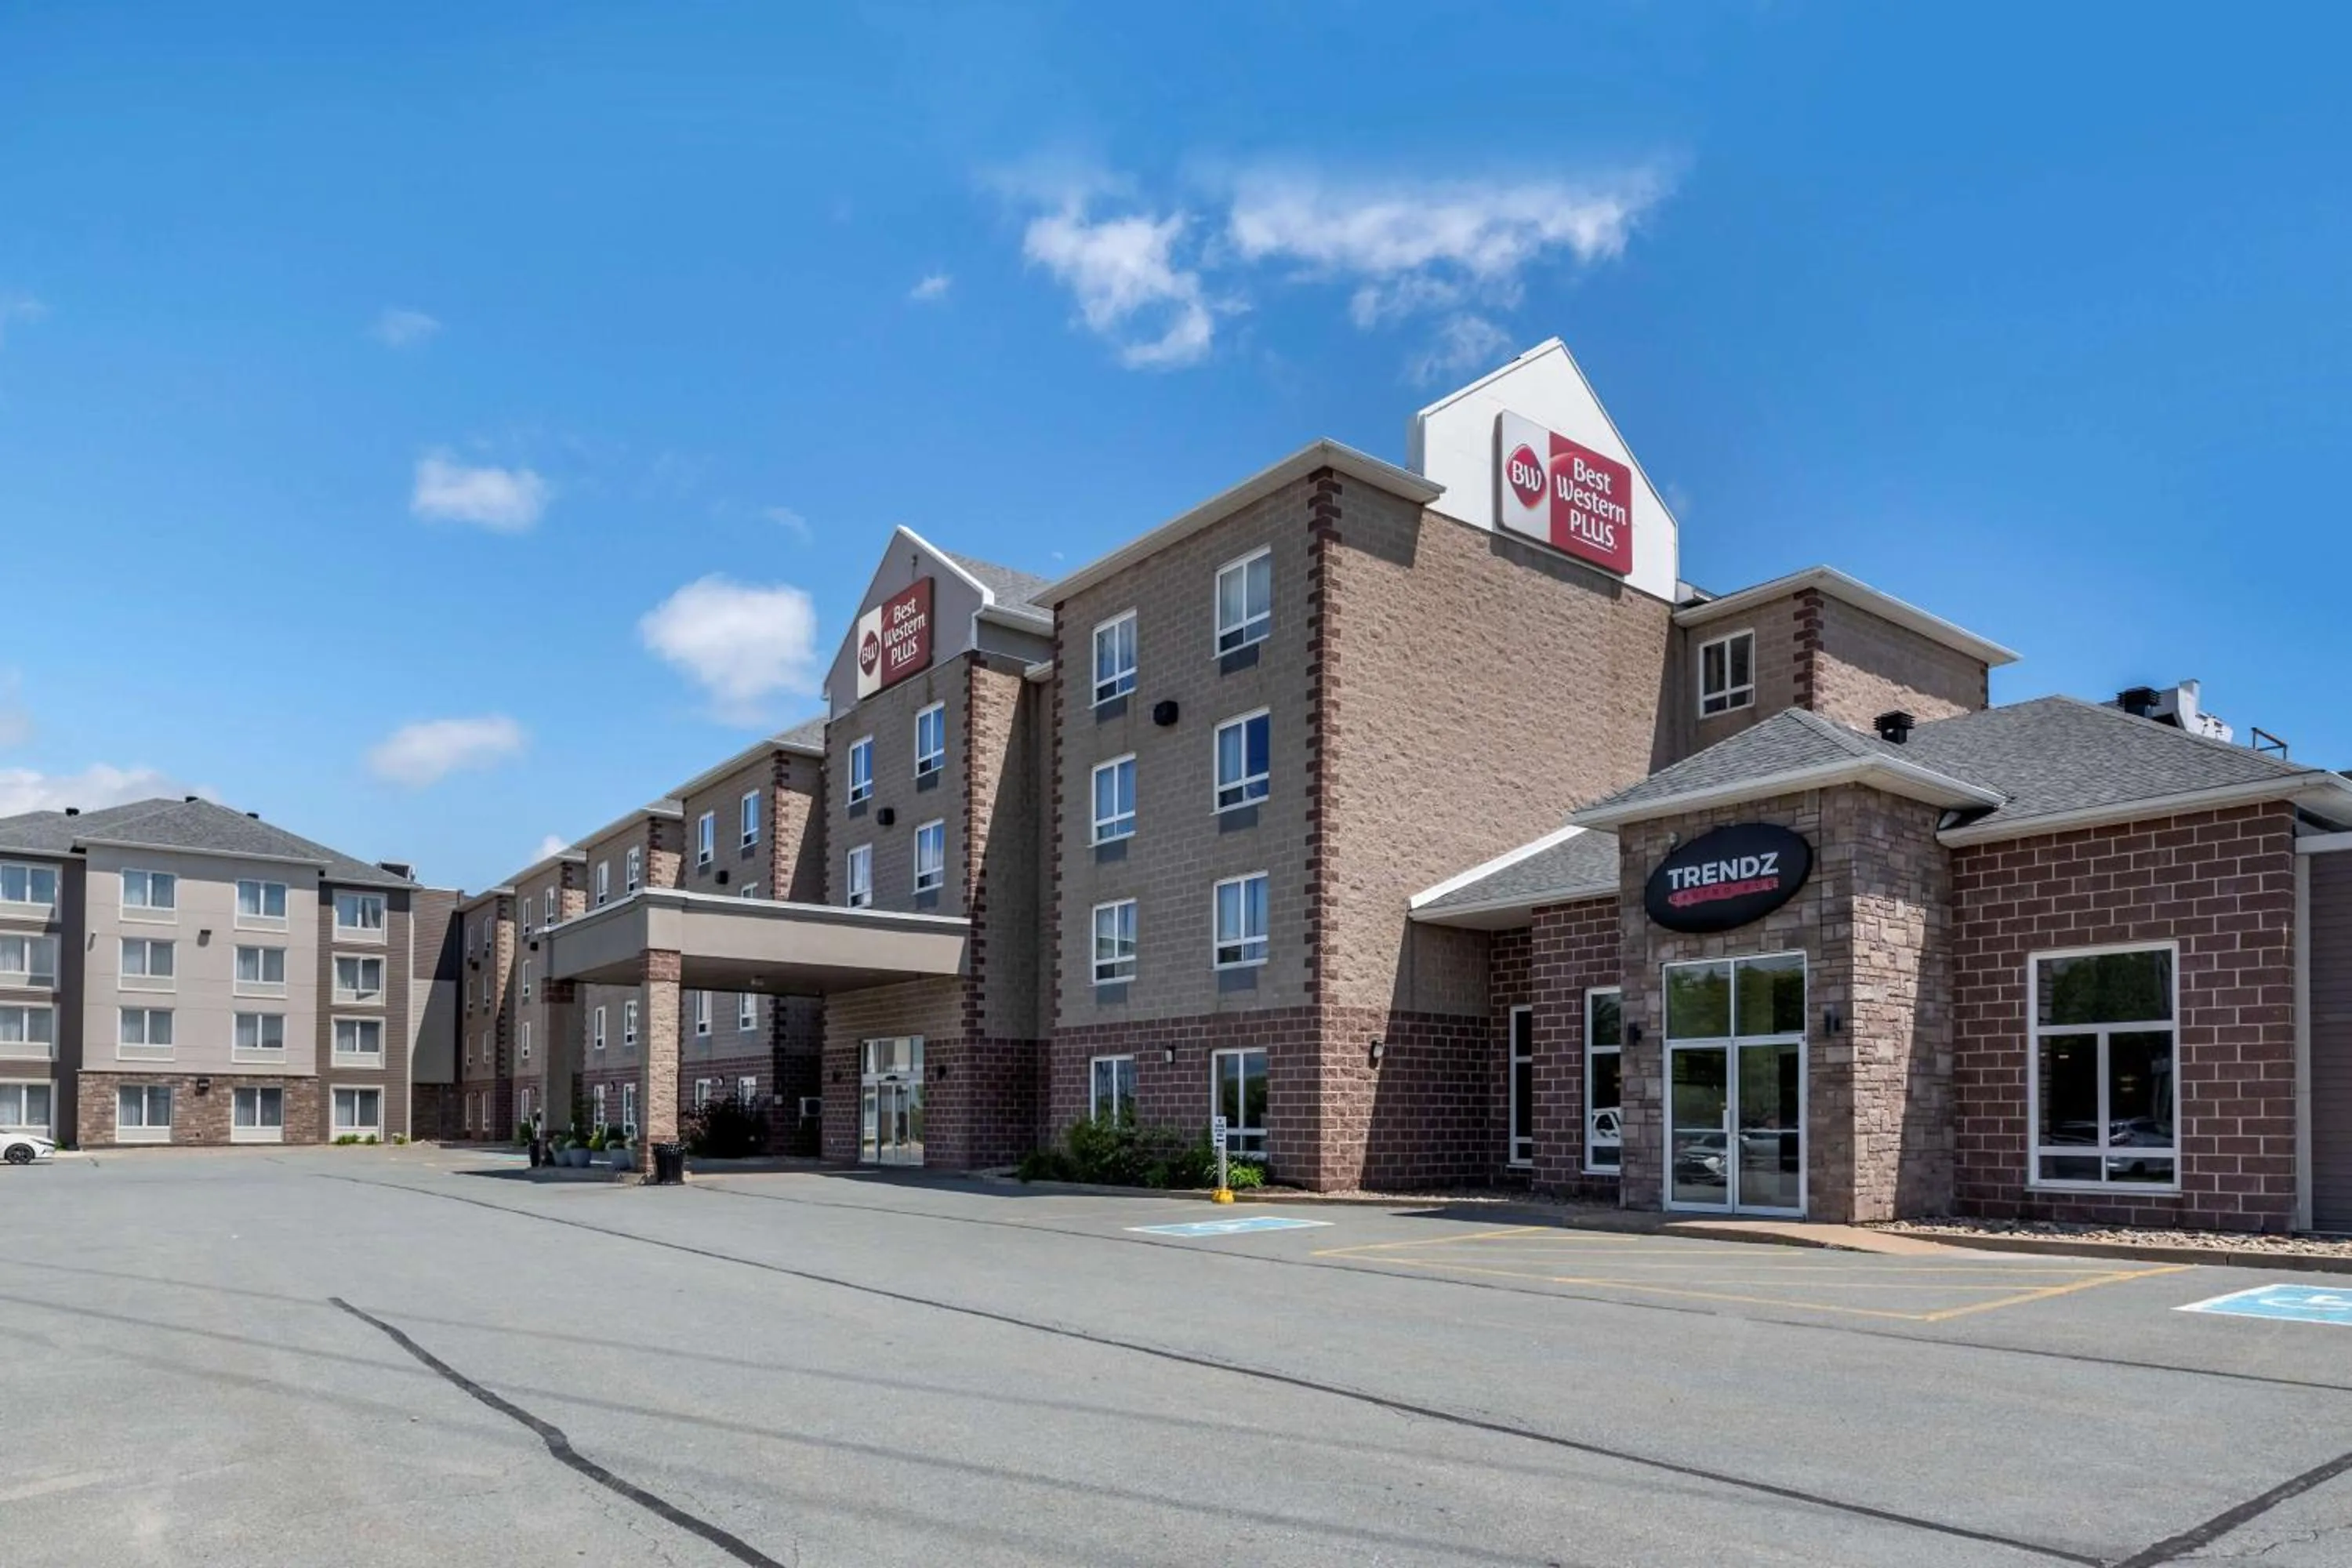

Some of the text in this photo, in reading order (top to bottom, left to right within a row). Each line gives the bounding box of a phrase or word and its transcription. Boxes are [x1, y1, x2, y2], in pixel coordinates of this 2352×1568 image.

[1512, 460, 1541, 492] BW
[1573, 458, 1611, 495] Best
[1556, 474, 1627, 525] Western
[1570, 509, 1615, 547] PLUS
[893, 597, 916, 624] Best
[884, 612, 926, 649] Western
[862, 641, 877, 664] BW
[891, 637, 917, 665] PLUS
[1668, 851, 1779, 890] TRENDZ
